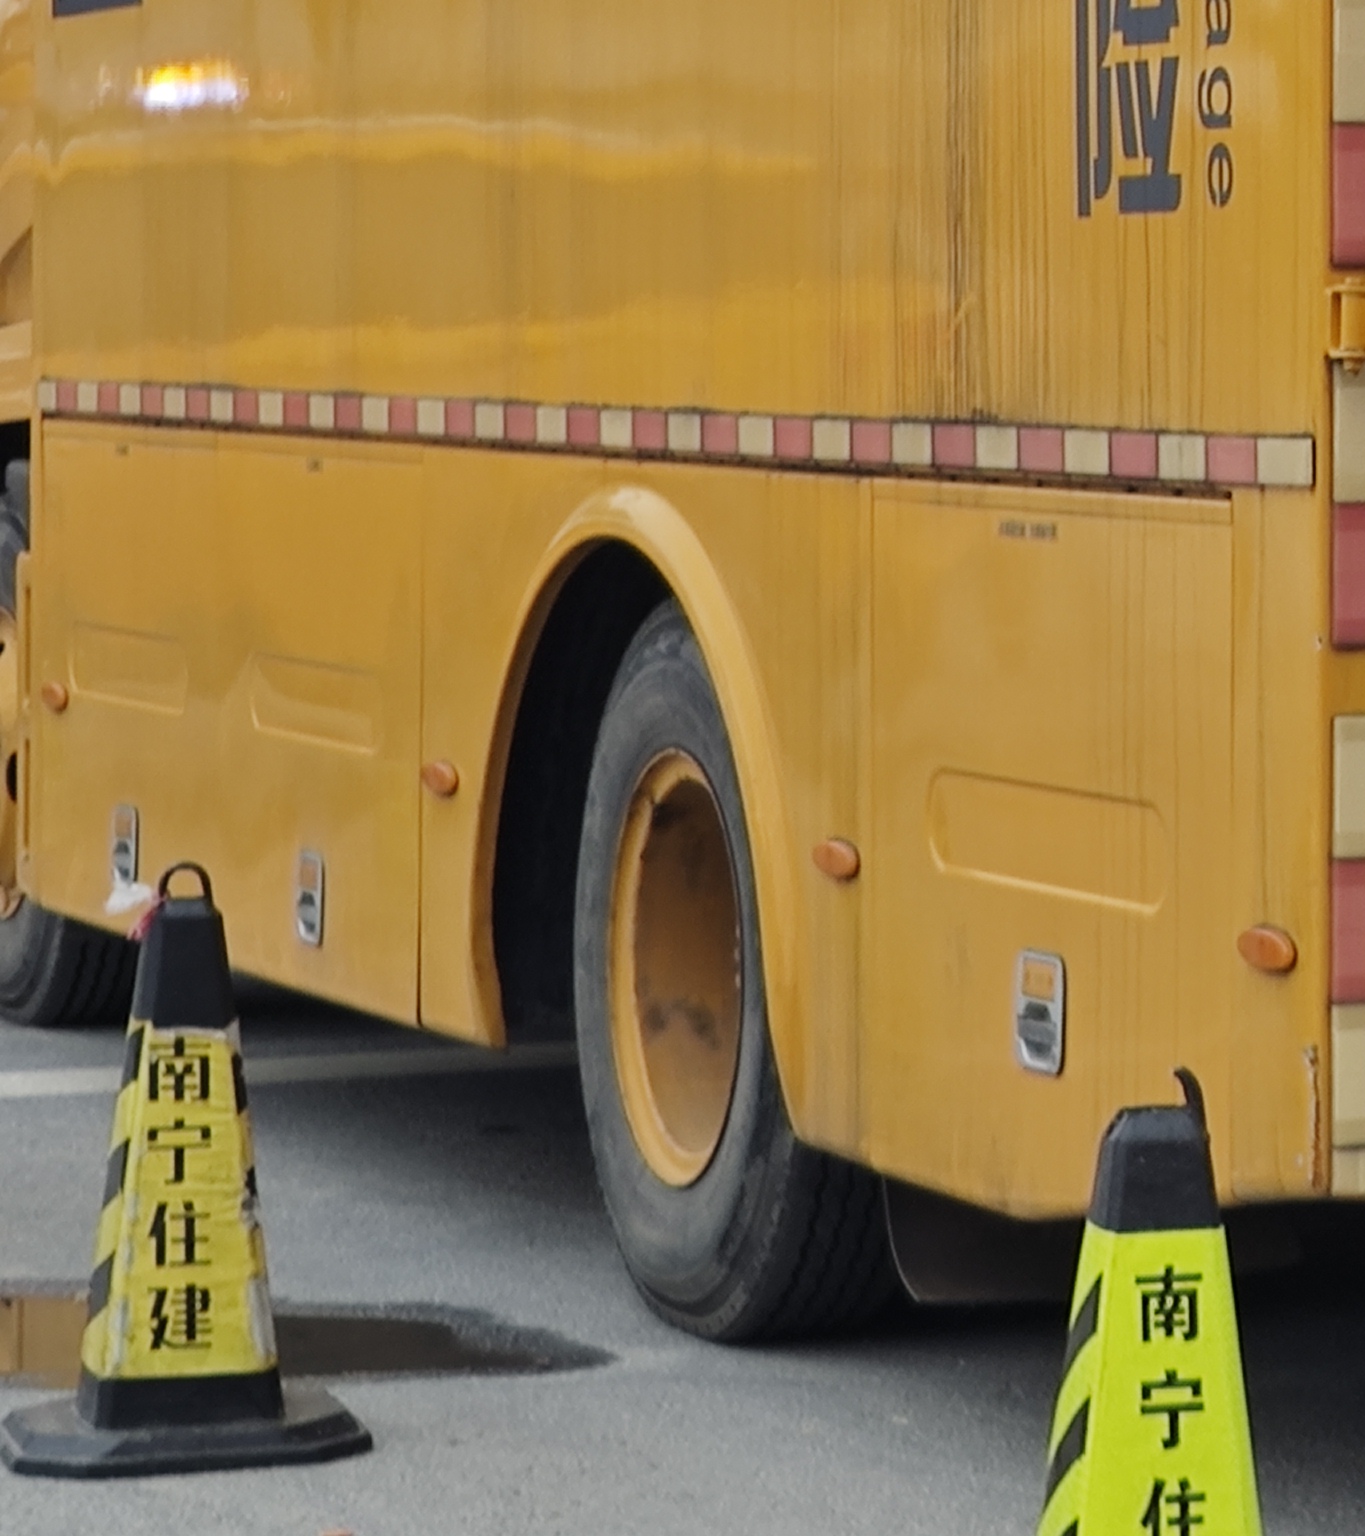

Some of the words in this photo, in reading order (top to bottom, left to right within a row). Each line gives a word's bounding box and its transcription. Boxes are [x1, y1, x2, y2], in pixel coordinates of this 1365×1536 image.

[147, 1035, 213, 1352] 南宁住建
[1134, 1264, 1206, 1536] 南宁住
